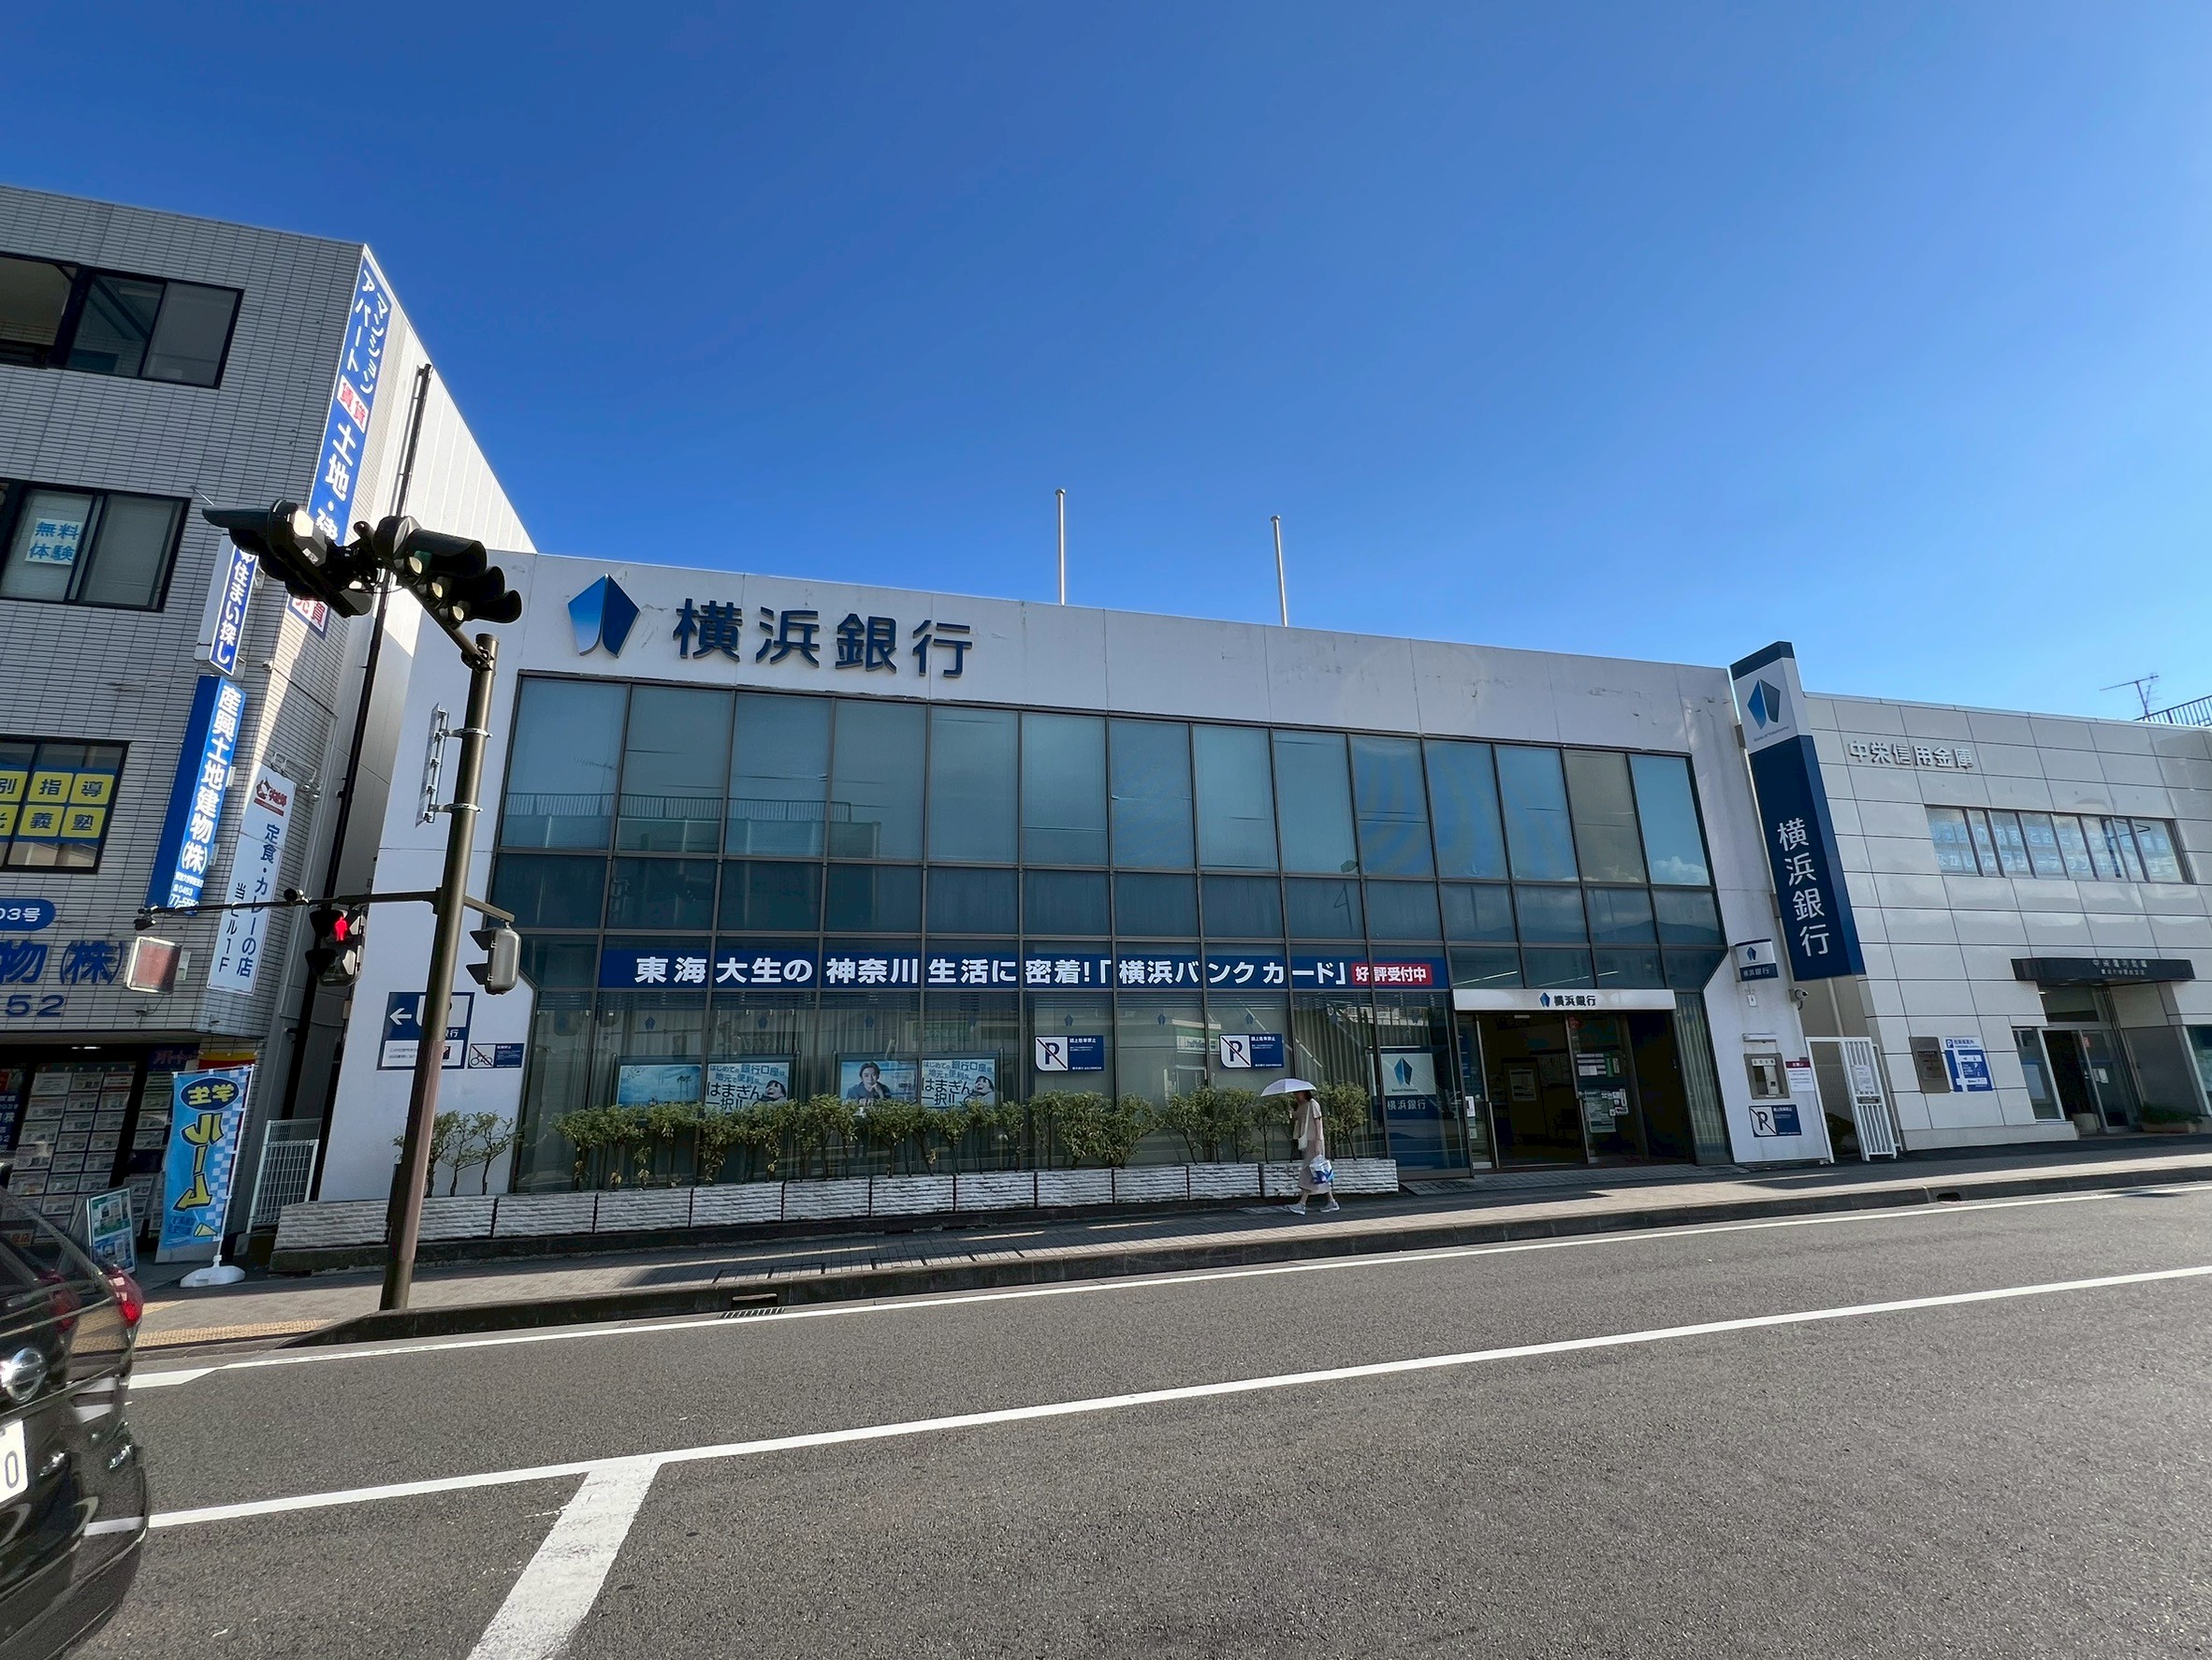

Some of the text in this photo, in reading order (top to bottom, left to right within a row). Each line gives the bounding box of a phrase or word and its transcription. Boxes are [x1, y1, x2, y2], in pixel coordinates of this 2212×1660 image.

[346, 269, 376, 373] アパート
[359, 292, 389, 395] マンション
[340, 381, 368, 430] 賃貸
[35, 521, 80, 540] 無料
[29, 543, 75, 561] 体験
[673, 597, 973, 678] 横浜銀行
[1848, 740, 1974, 769] 中栄信用金庫
[1776, 817, 1831, 958] 横浜銀行
[237, 823, 281, 979] 定食・カレーの店
[1355, 965, 1428, 983] 好評受付中
[1553, 995, 1596, 1007] 横浜銀行
[706, 1081, 763, 1100] はまぎん
[922, 1077, 973, 1096] はまぎん
[1387, 1099, 1426, 1111] 横浜銀行
